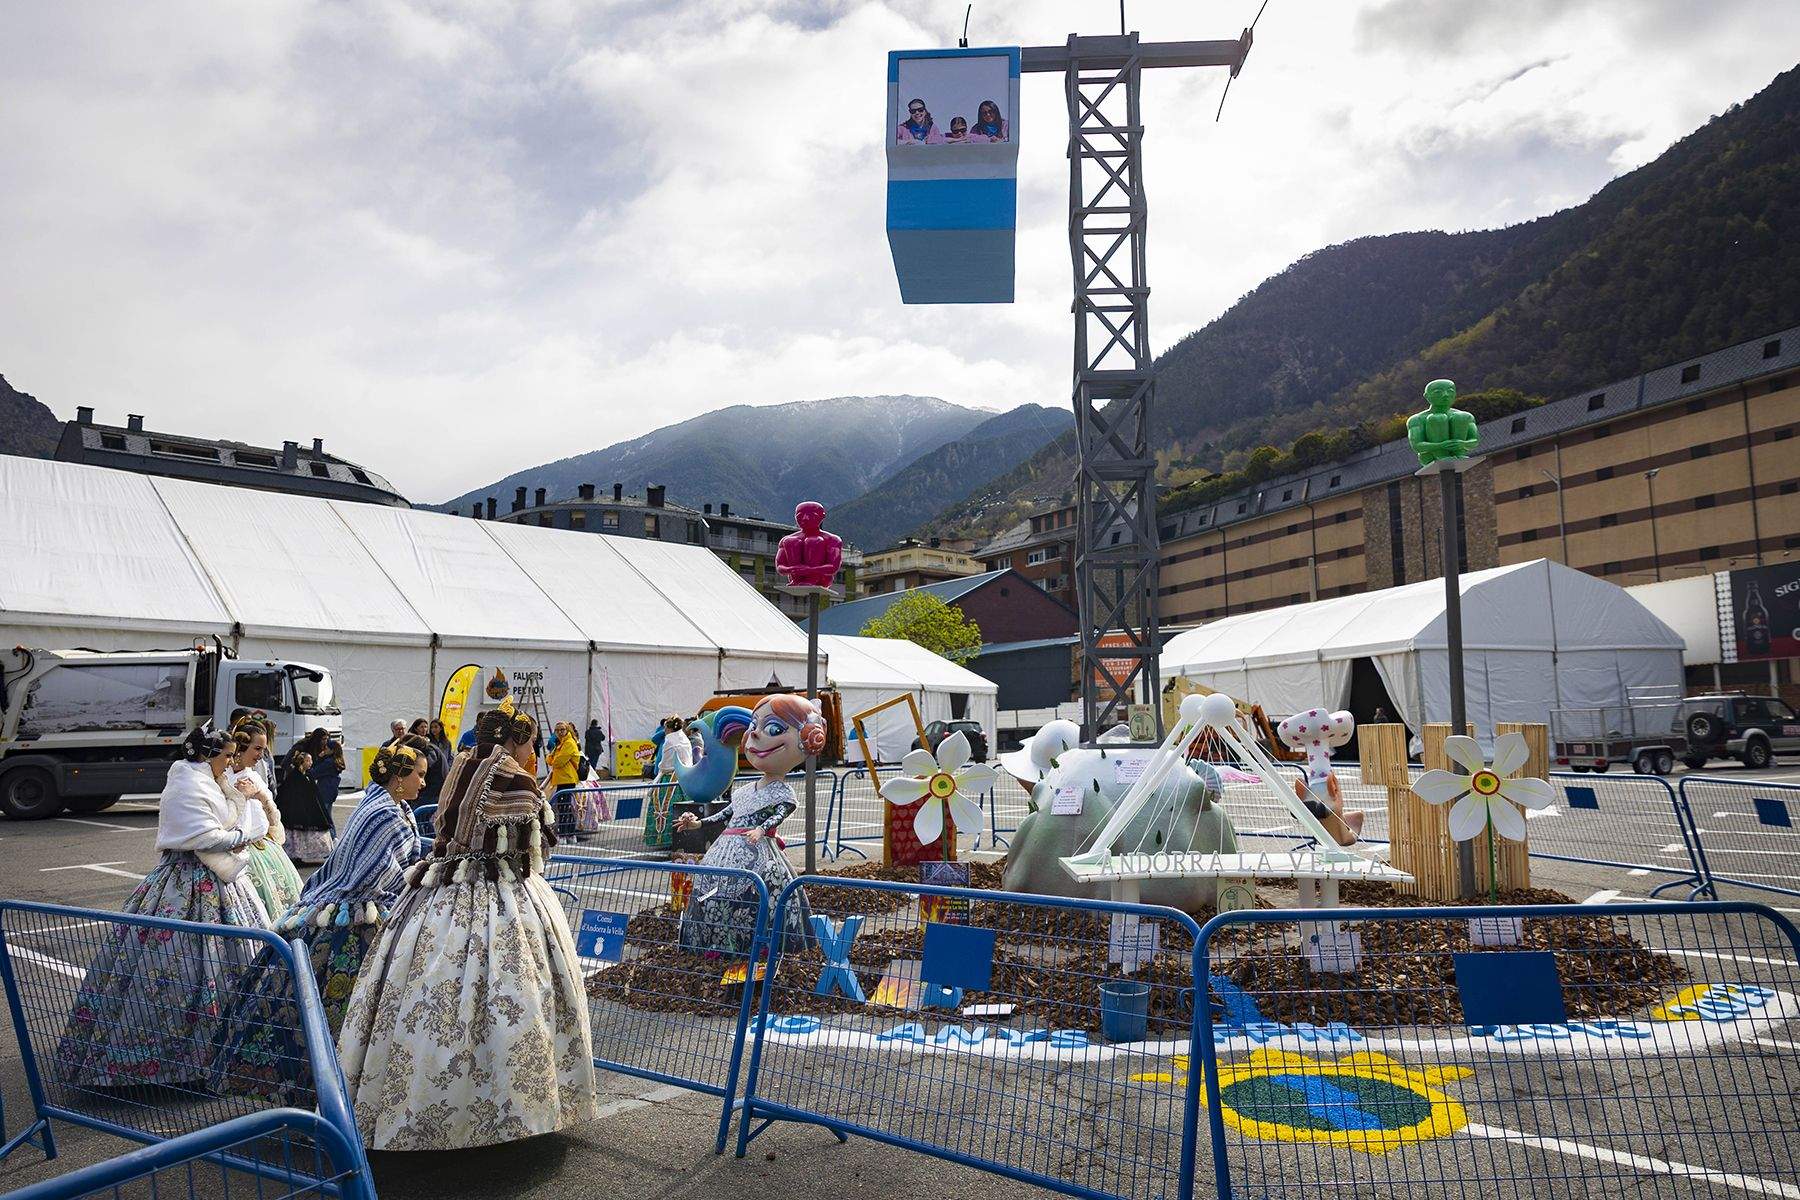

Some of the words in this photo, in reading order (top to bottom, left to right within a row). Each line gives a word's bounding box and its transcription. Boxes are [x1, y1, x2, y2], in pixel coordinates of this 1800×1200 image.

[1775, 578, 1800, 597] SIG
[1101, 850, 1224, 875] ANDORRA
[1238, 851, 1273, 871] LA
[1288, 851, 1386, 876] VELLA
[876, 1022, 1091, 1049] ANYS
